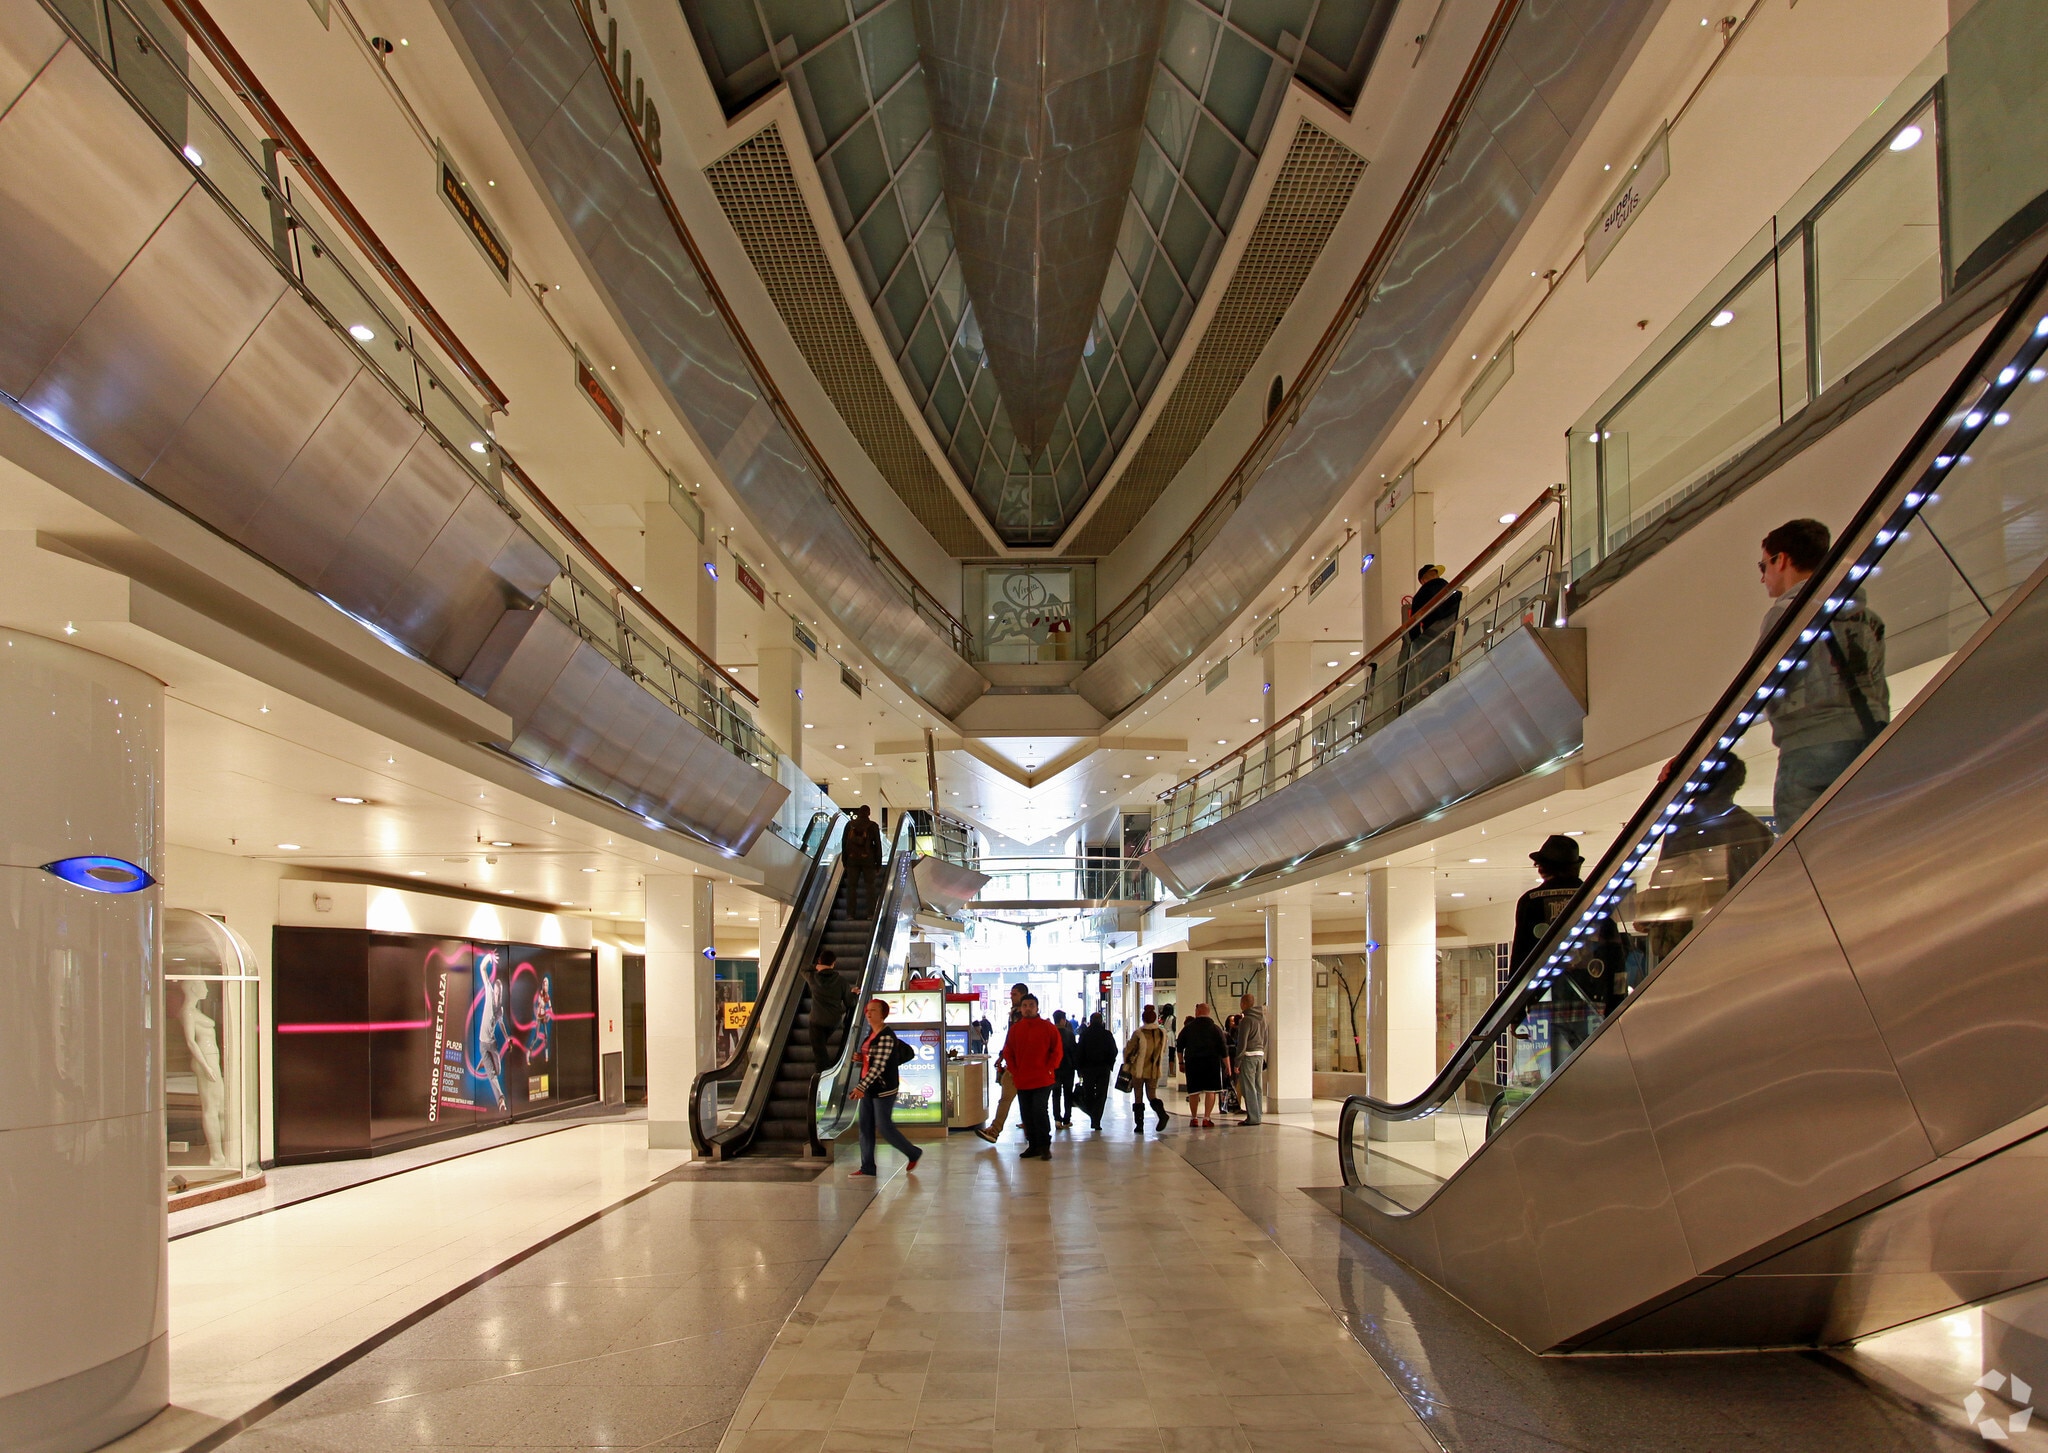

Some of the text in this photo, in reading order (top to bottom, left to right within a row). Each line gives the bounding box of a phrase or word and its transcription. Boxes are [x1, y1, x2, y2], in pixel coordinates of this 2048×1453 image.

[446, 179, 470, 217] GAMES
[1604, 186, 1633, 233] super
[1616, 192, 1640, 229] cuts
[989, 603, 1071, 640] ACTIV
[1012, 678, 1040, 701] Virgin
[729, 1003, 746, 1015] sale
[428, 973, 447, 1122] OXFORD STREET PLAZA
[446, 1040, 463, 1051] PLAZA
